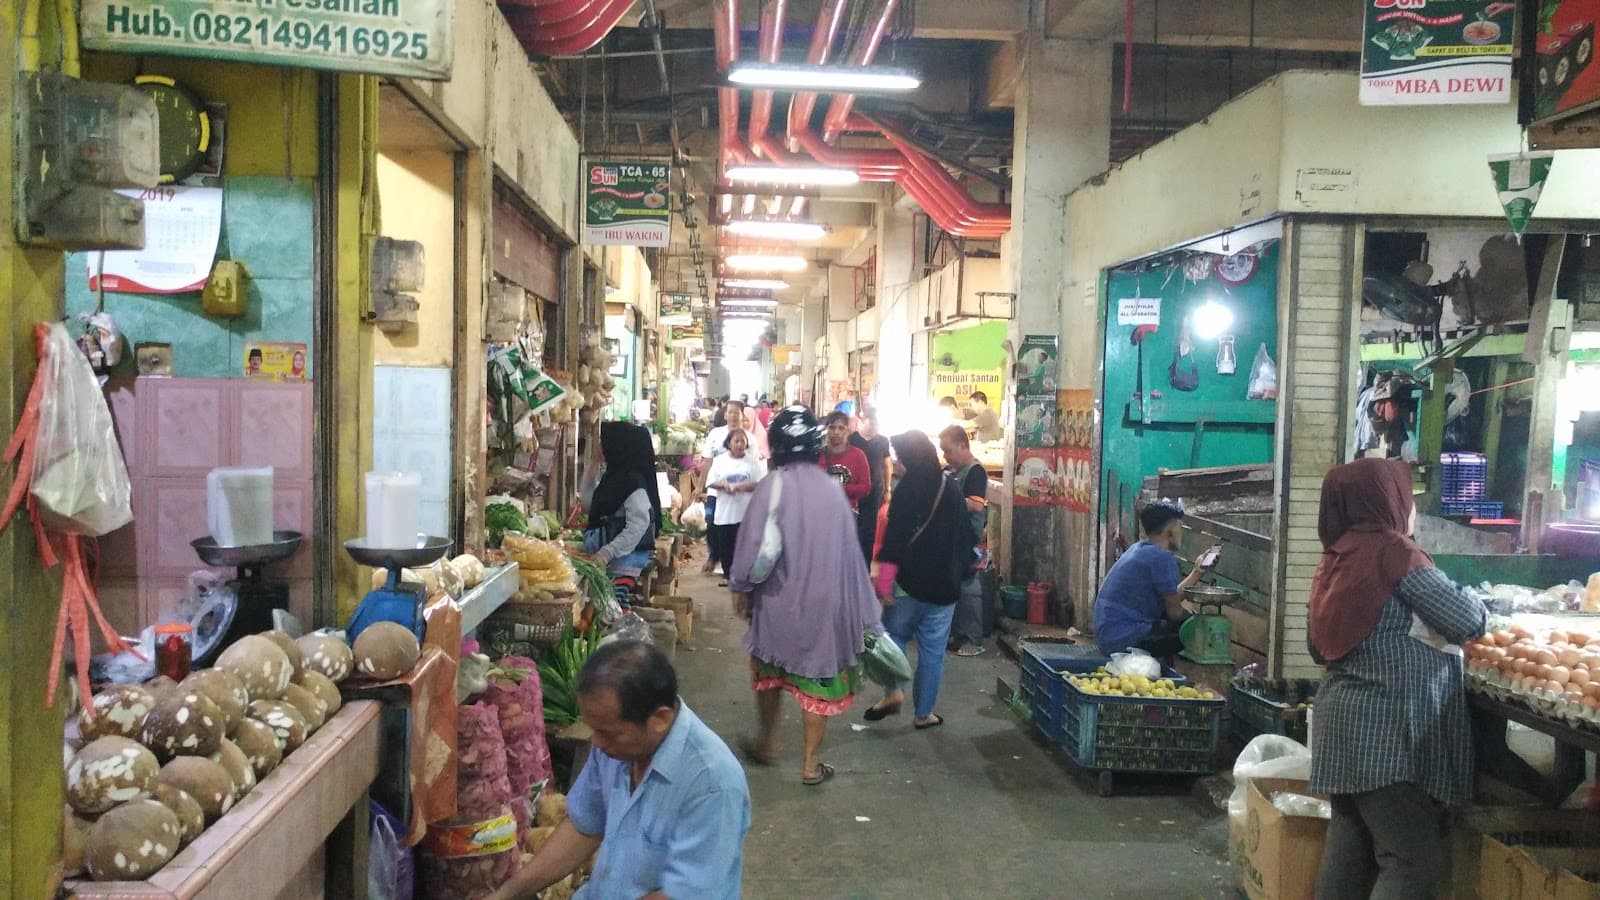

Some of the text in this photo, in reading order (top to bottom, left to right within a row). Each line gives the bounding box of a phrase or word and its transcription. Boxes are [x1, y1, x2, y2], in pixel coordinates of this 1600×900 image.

[264, 0, 398, 16] sanan
[107, 6, 428, 60] Hub. 082149416925
[1367, 78, 1504, 94] TOKO MBA DEWI
[619, 165, 643, 177] TCA
[652, 166, 666, 177] 65
[139, 188, 175, 202] 2019
[605, 230, 622, 240] IBU
[625, 231, 663, 241] WAKINI
[970, 373, 999, 383] Santan
